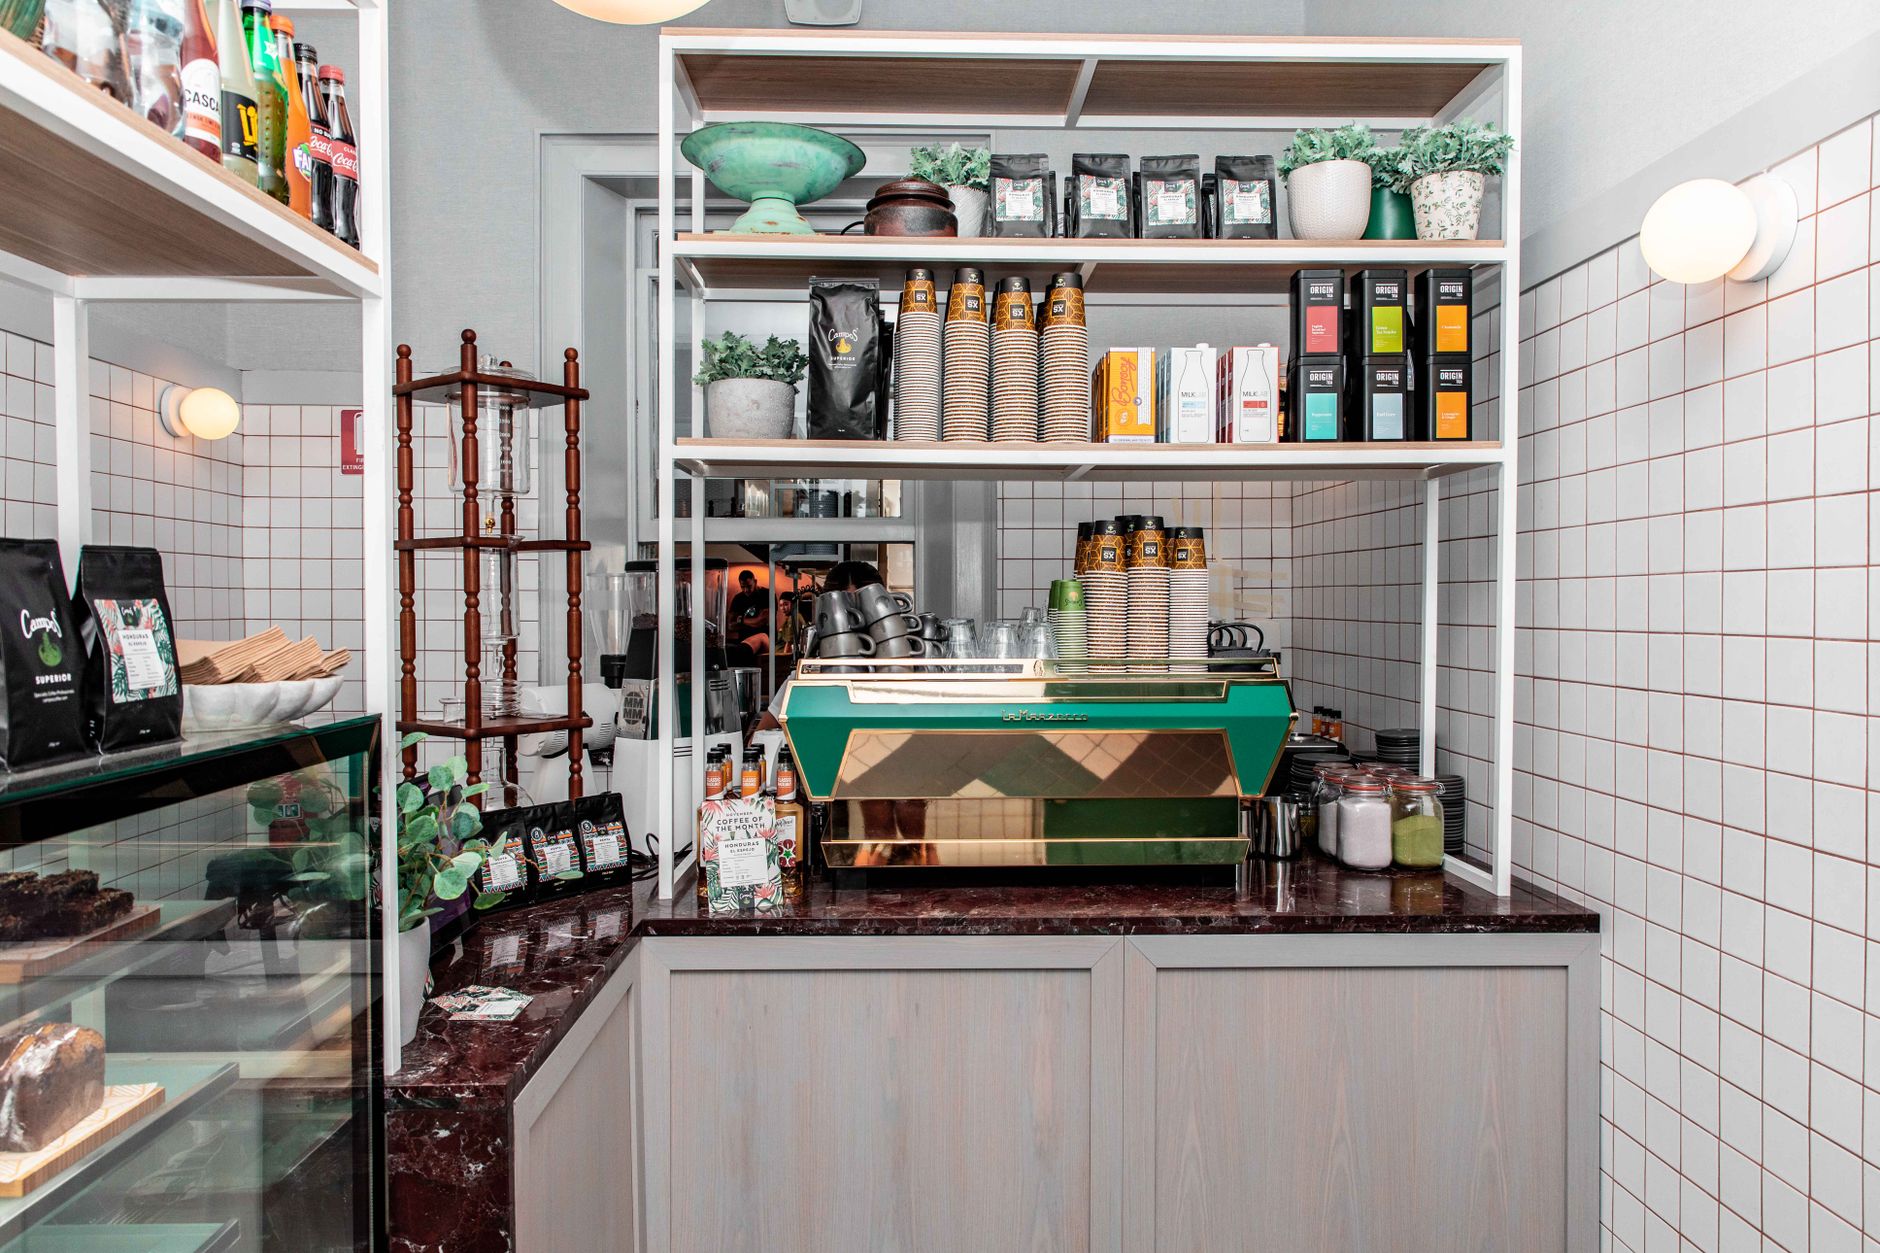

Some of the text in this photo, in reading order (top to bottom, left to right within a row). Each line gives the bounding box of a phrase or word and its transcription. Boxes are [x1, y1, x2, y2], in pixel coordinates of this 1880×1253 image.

[1310, 286, 1334, 294] ORIGIN
[1375, 286, 1399, 294] ORIGIN
[1440, 285, 1463, 293] ORIGIN
[827, 328, 859, 342] Campos
[1309, 373, 1334, 381] ORIGIN
[1376, 373, 1400, 381] ORIGIN
[1440, 372, 1463, 380] ORIGIN
[20, 608, 62, 639] Campos
[35, 673, 72, 685] SUPERIOR
[716, 817, 750, 826] COFFEE
[735, 823, 765, 831] MONTH
[724, 841, 760, 849] HONDURAS
